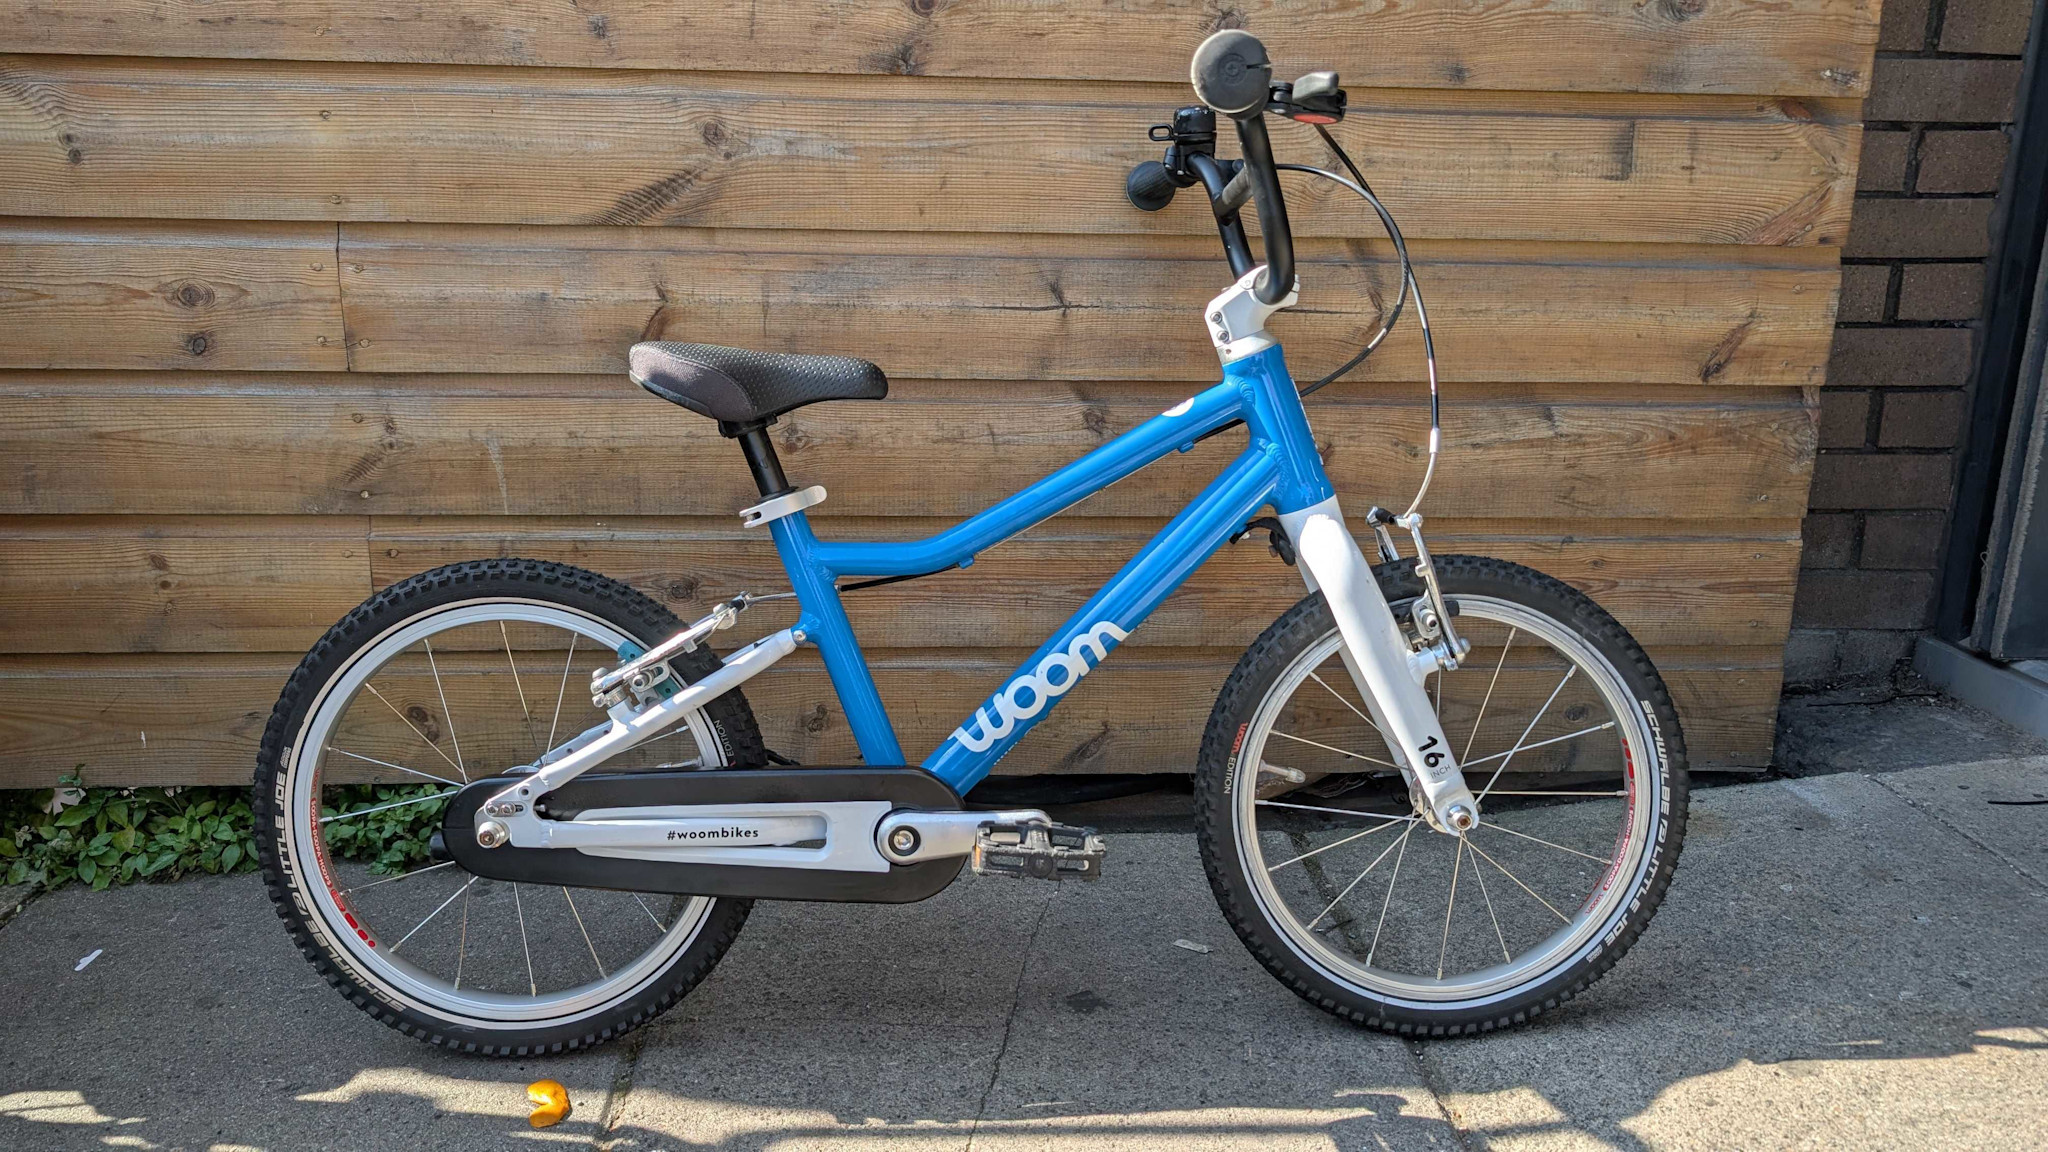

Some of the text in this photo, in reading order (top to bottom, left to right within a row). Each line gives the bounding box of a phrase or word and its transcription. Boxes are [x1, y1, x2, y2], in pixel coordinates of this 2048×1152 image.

[947, 621, 1130, 752] woom
[714, 720, 734, 757] EDITION
[1418, 735, 1445, 768] 16
[1223, 757, 1236, 794] EDITION
[1430, 764, 1451, 778] INCH
[275, 771, 287, 811] JOE
[667, 826, 759, 841] #woombikes
[1604, 700, 1671, 947] SCHWALBE LITTLE JOE
[275, 814, 298, 889] LITTLE
[304, 919, 407, 1012] SCHWALBE
